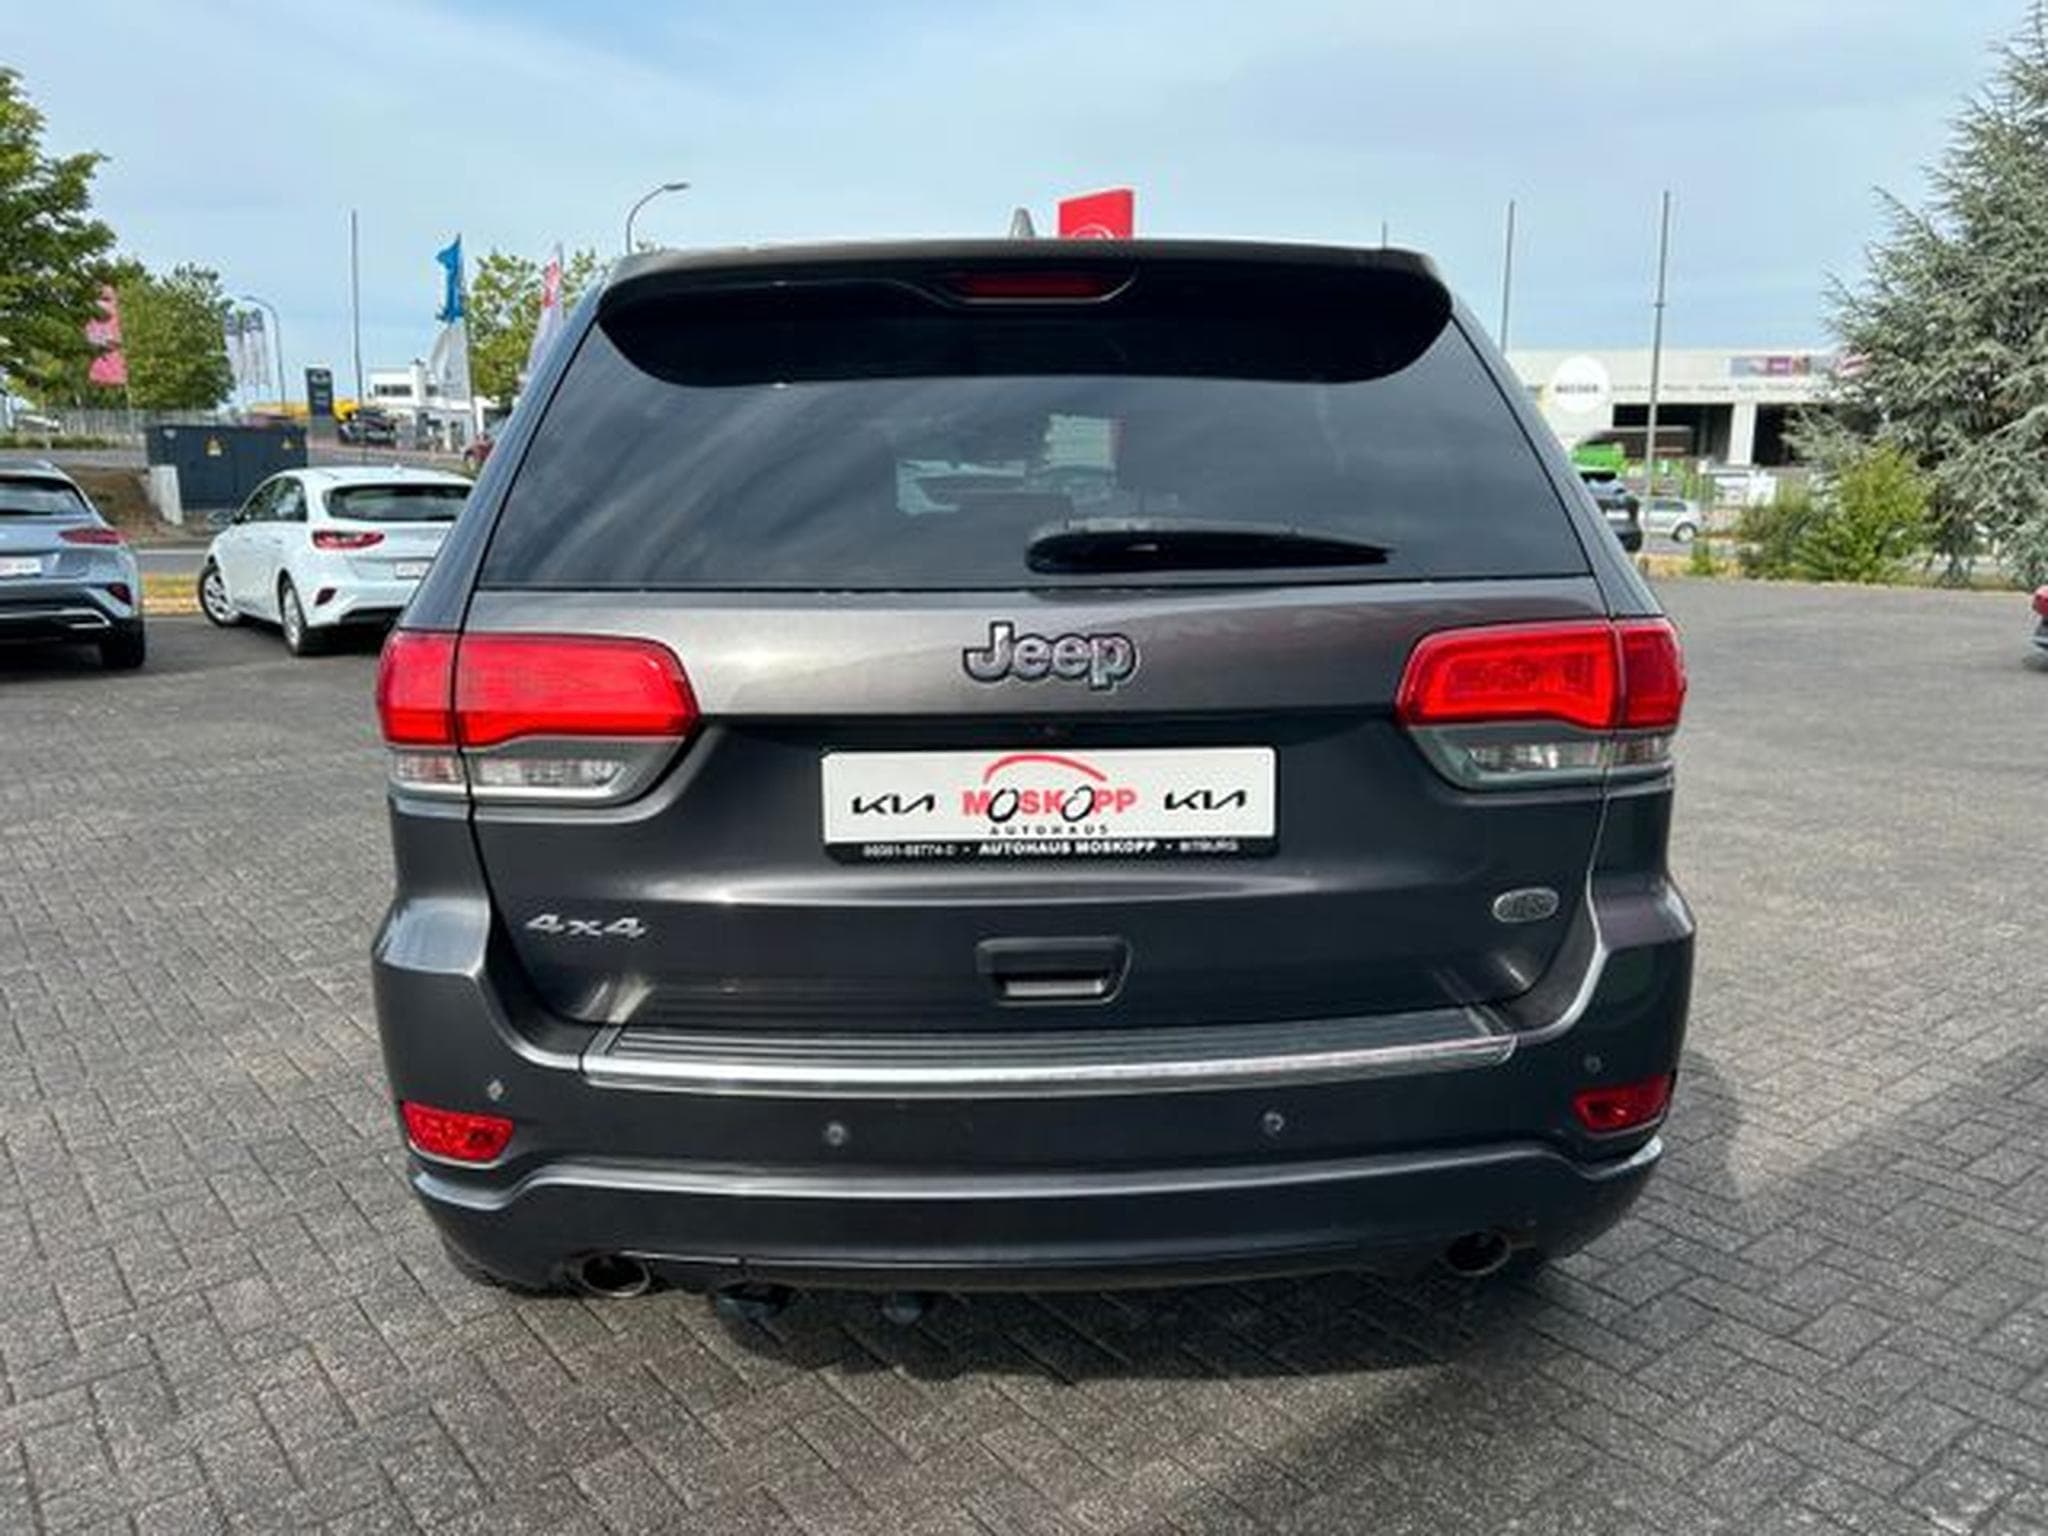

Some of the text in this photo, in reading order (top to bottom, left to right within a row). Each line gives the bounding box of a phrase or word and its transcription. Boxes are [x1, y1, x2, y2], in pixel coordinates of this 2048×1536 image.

[962, 620, 1136, 690] Jeep
[852, 793, 935, 814] KIA
[963, 786, 1138, 823] MOSKOPP
[1165, 789, 1246, 810] KIA
[989, 825, 1109, 835] AUTOHAUS
[978, 842, 1071, 855] AUTOHAUS
[1075, 841, 1157, 853] MOSKOPP
